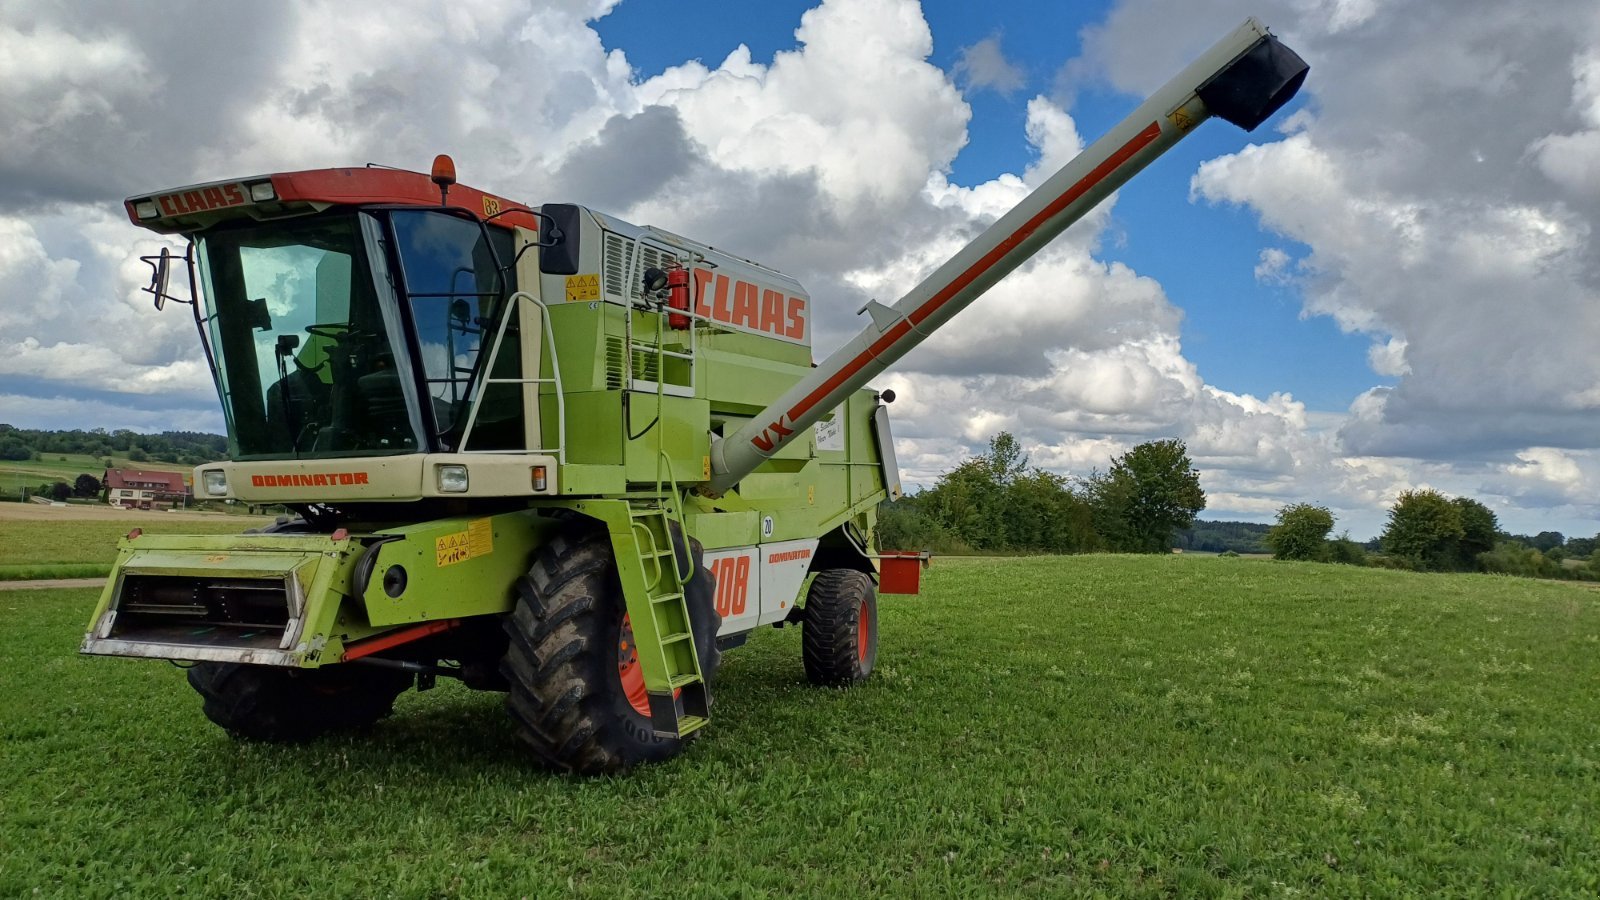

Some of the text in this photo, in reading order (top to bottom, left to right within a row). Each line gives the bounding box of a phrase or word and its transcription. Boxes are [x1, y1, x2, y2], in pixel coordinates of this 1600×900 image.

[159, 183, 245, 216] CLAAS
[693, 267, 805, 340] CLAAS
[750, 414, 794, 452] VX
[251, 472, 369, 487] DOMINATOR
[764, 519, 772, 534] 20
[768, 549, 811, 564] DOMINATOR
